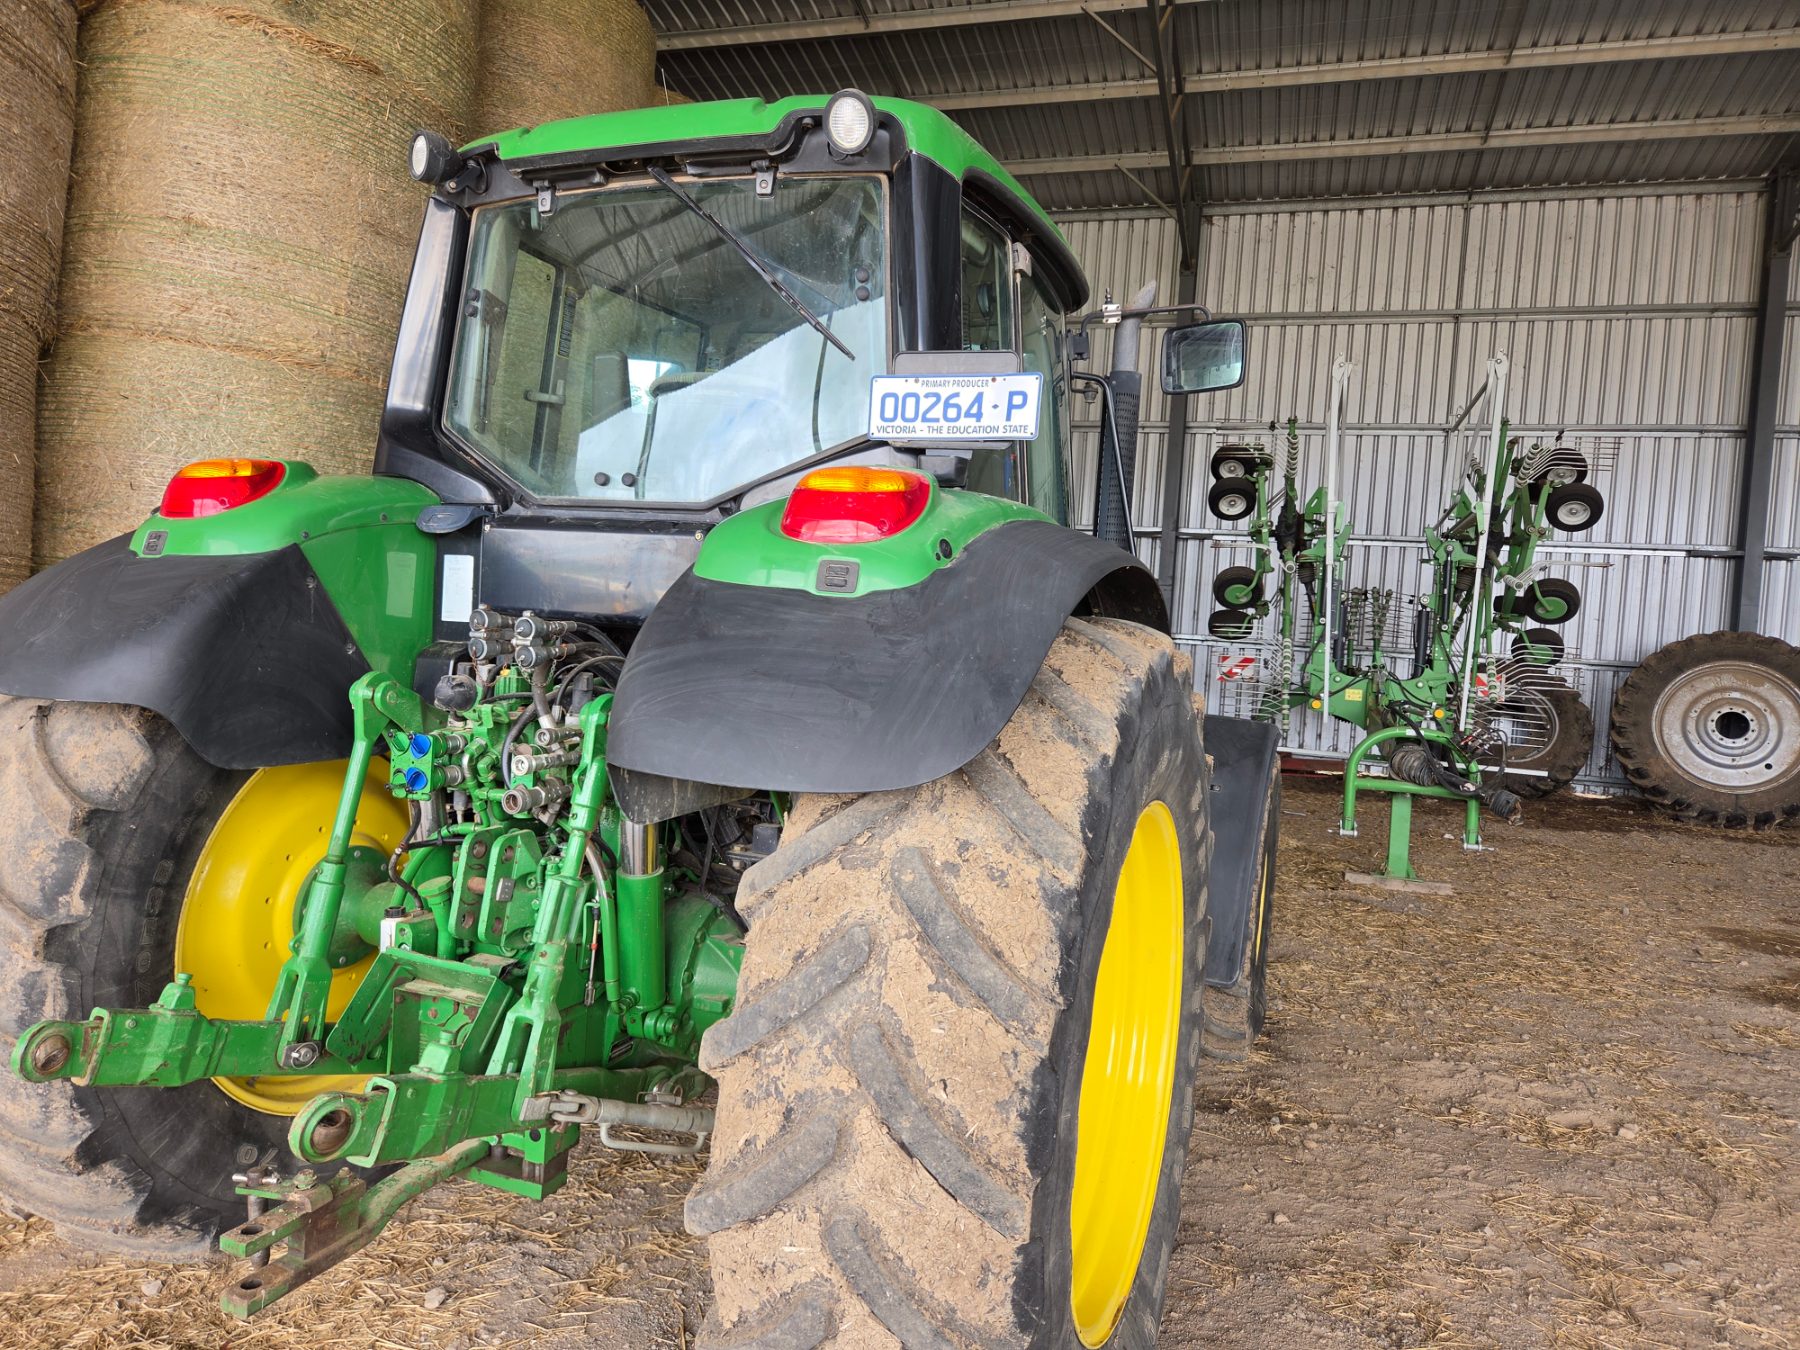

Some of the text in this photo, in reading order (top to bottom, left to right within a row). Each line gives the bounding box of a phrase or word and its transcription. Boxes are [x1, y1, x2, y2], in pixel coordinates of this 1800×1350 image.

[921, 379, 989, 388] PRIMARY PRODUCER
[880, 390, 1028, 423] 00264 P
[876, 425, 917, 434] VICTORIA
[927, 425, 943, 434] THE
[947, 425, 1000, 434] EDUCATION
[1002, 425, 1029, 434] STATE
